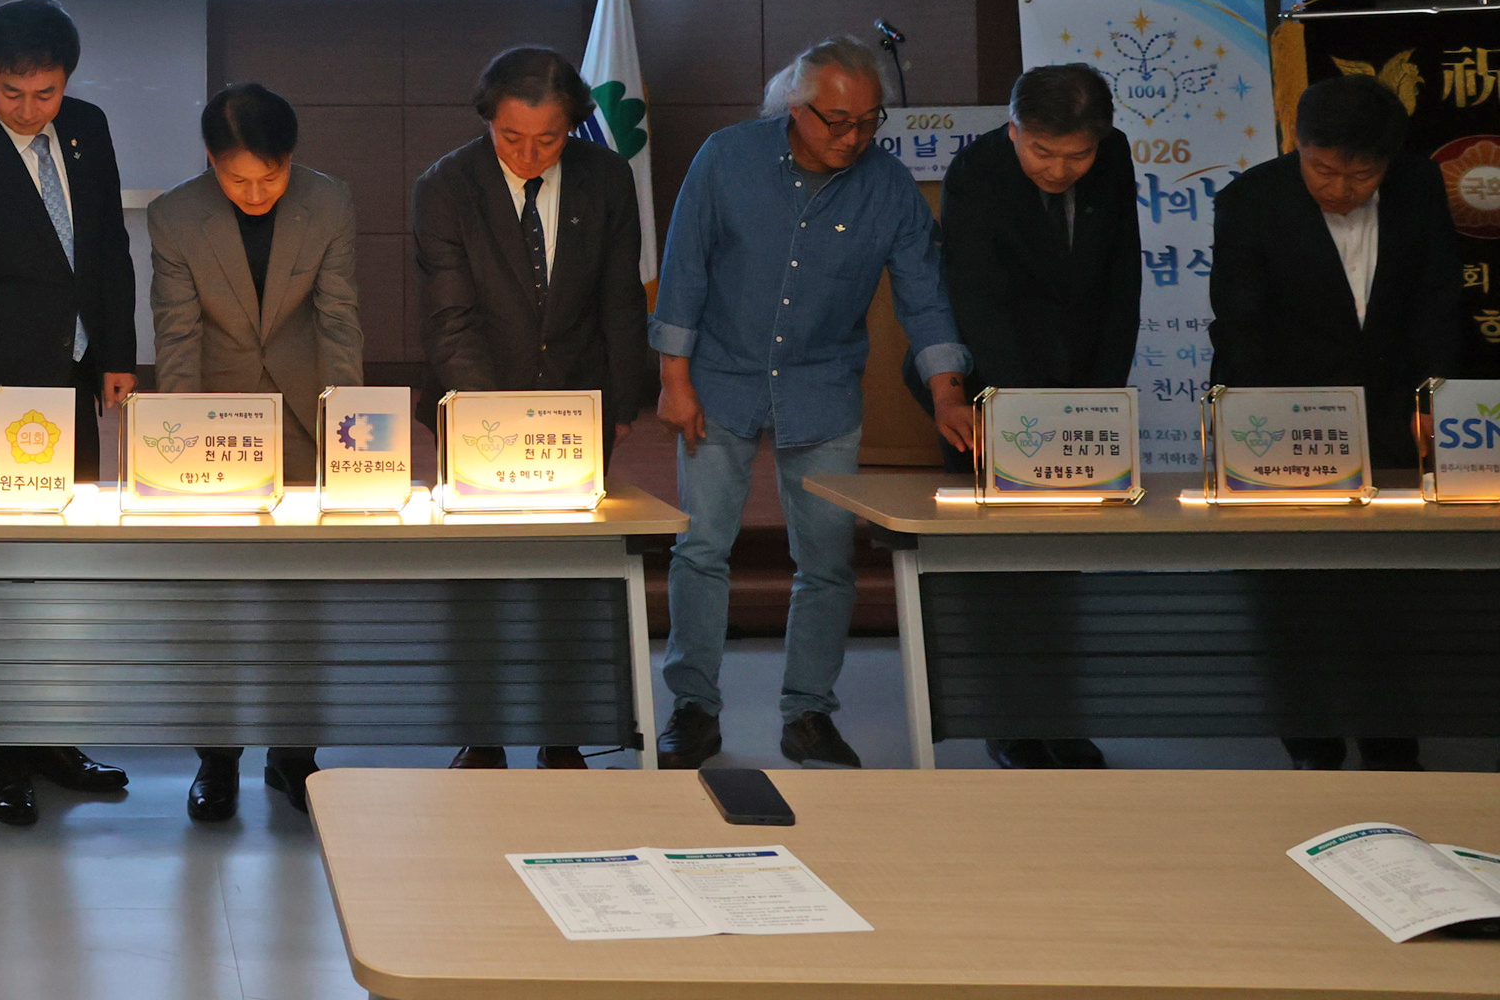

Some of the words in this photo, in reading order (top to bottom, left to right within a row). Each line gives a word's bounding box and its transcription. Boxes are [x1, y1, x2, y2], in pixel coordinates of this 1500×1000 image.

[1127, 85, 1166, 99] 1004
[905, 114, 954, 130] 2026
[914, 134, 938, 158] 날
[1132, 138, 1191, 164] 026
[1136, 173, 1197, 224] 사의
[1167, 318, 1180, 331] 더
[20, 431, 44, 446] 의회
[524, 433, 556, 445] 이웃을
[561, 433, 582, 445] 돕는
[1062, 430, 1094, 442] 이웃을
[1098, 430, 1119, 442] 돕는
[1291, 429, 1323, 441] 이웃을
[1327, 429, 1349, 441] 돕는
[161, 444, 180, 453] 1004
[205, 436, 237, 448] 이웃을
[242, 436, 263, 448] 돕는
[330, 460, 406, 473] 원주상공회의소
[1312, 465, 1338, 475] 사무소
[0, 475, 65, 491] 원주시의회
[496, 470, 555, 483] 일송메디칼
